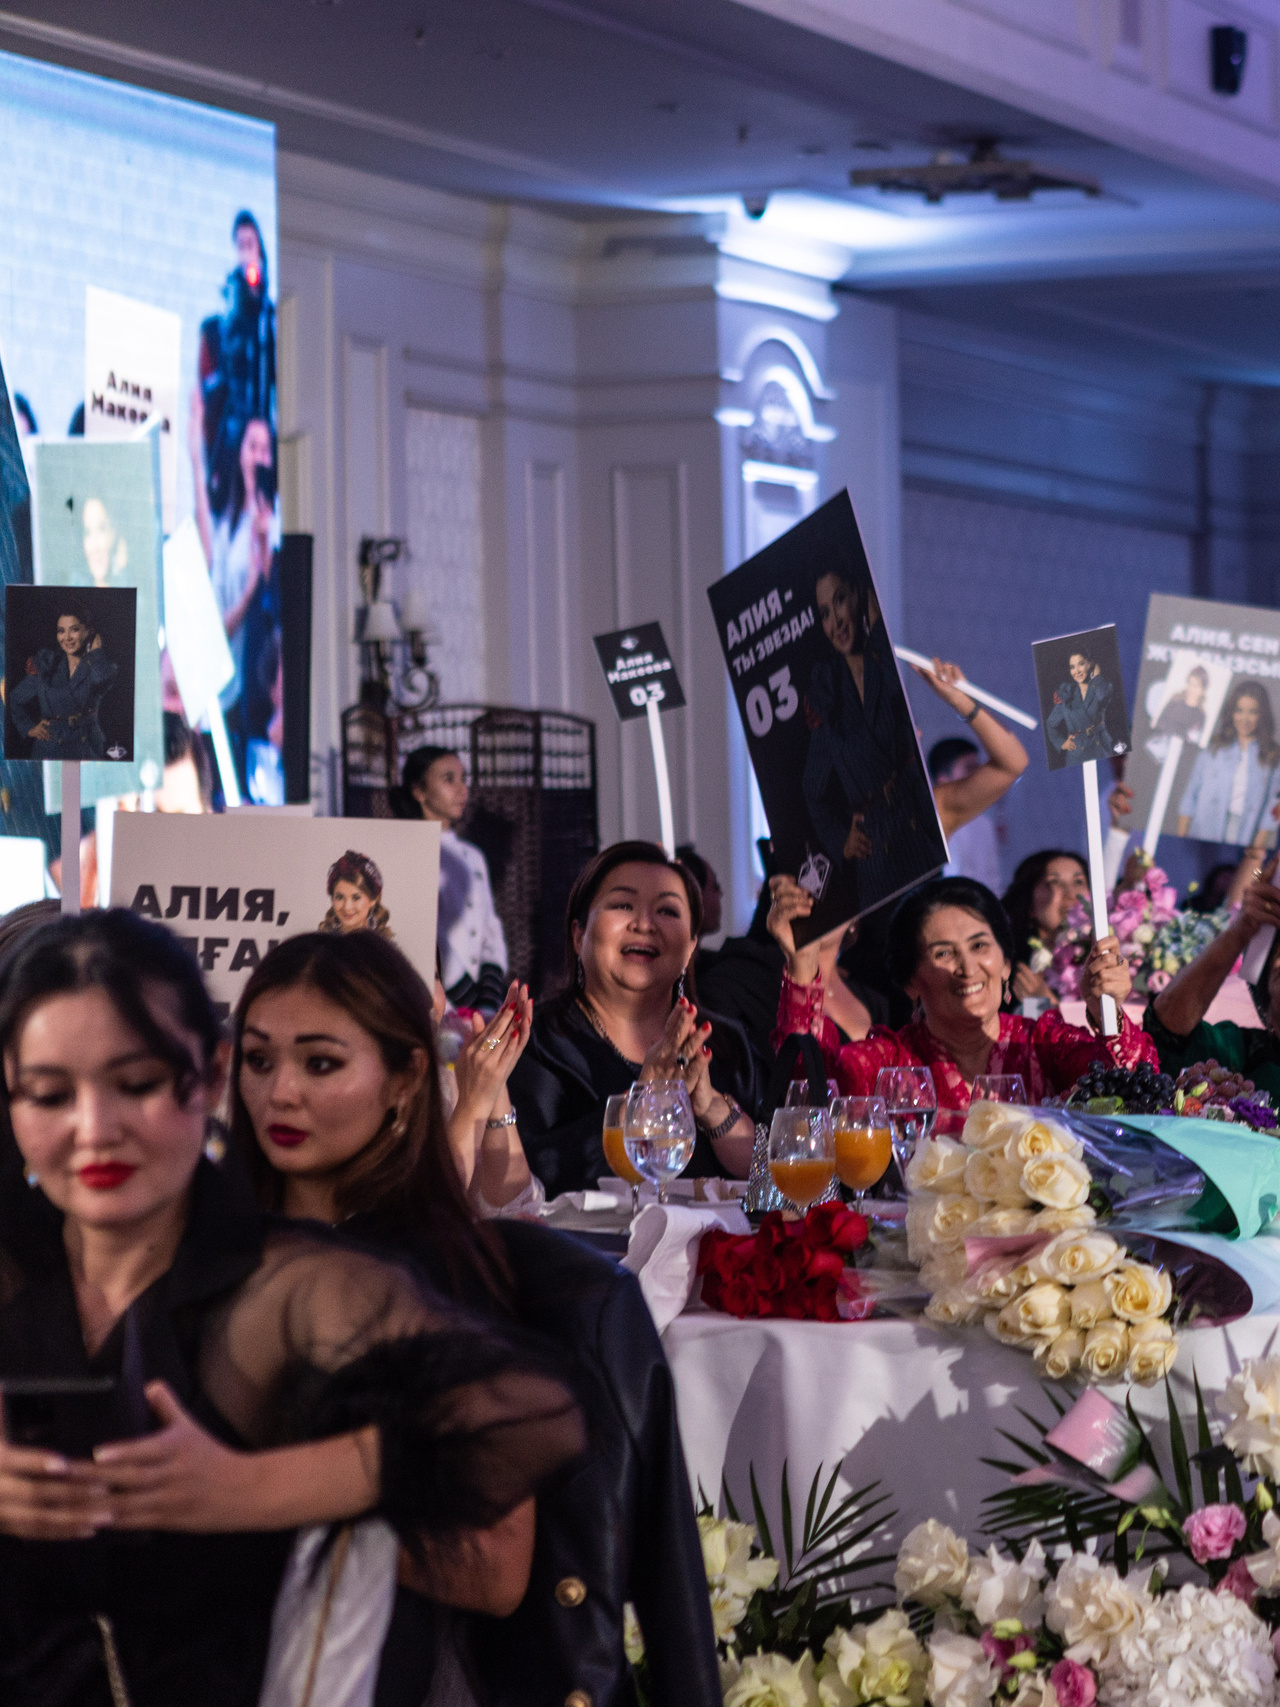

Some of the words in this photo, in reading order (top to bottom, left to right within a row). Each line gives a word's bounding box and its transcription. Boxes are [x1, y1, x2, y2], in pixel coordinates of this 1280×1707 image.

[107, 369, 152, 402] Алия
[727, 588, 783, 650] АЛИЯ
[616, 652, 653, 671] Алия
[732, 648, 756, 678] ТЫ
[755, 605, 815, 662] ЗВЕЗДА!
[629, 682, 666, 707] 03
[746, 664, 799, 738] 03
[130, 884, 290, 927] АЛИЯ,
